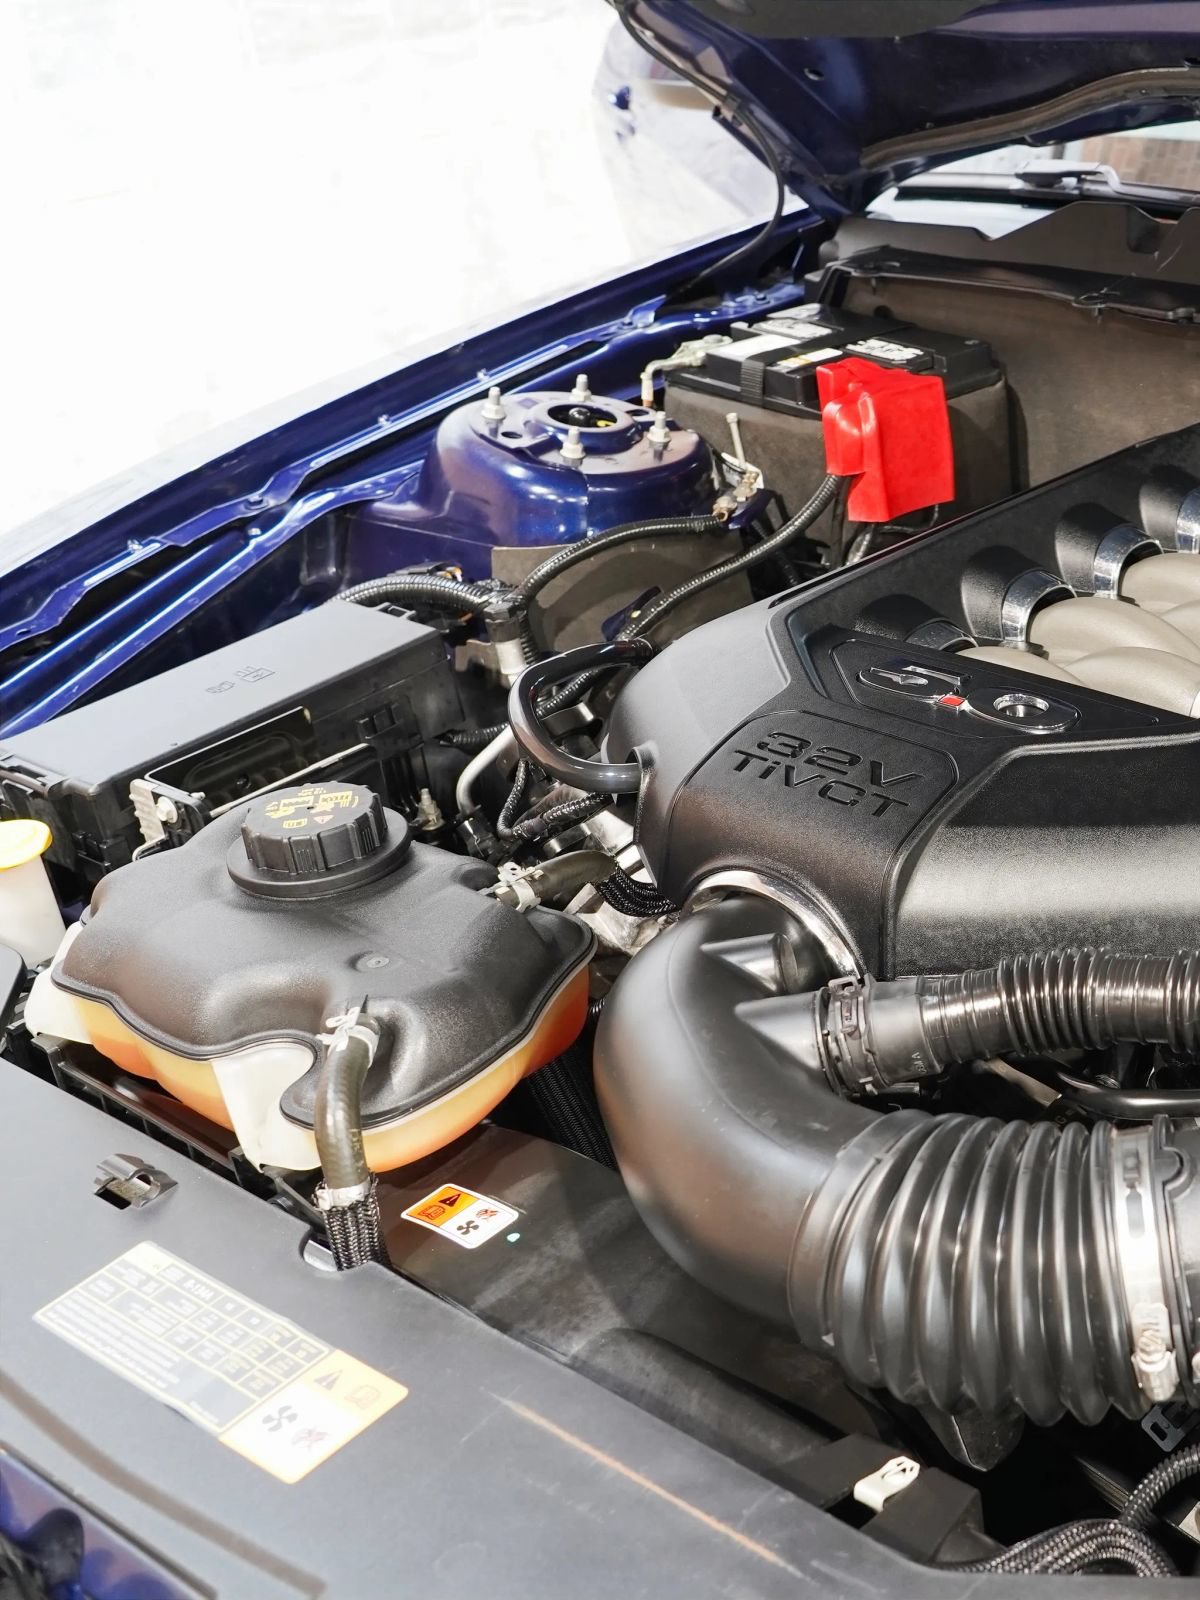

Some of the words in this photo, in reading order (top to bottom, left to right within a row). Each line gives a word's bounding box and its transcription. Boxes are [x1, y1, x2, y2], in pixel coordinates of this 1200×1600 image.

[855, 664, 1083, 735] 5.0
[734, 749, 910, 817] TiVCT
[757, 731, 926, 787] 32V
